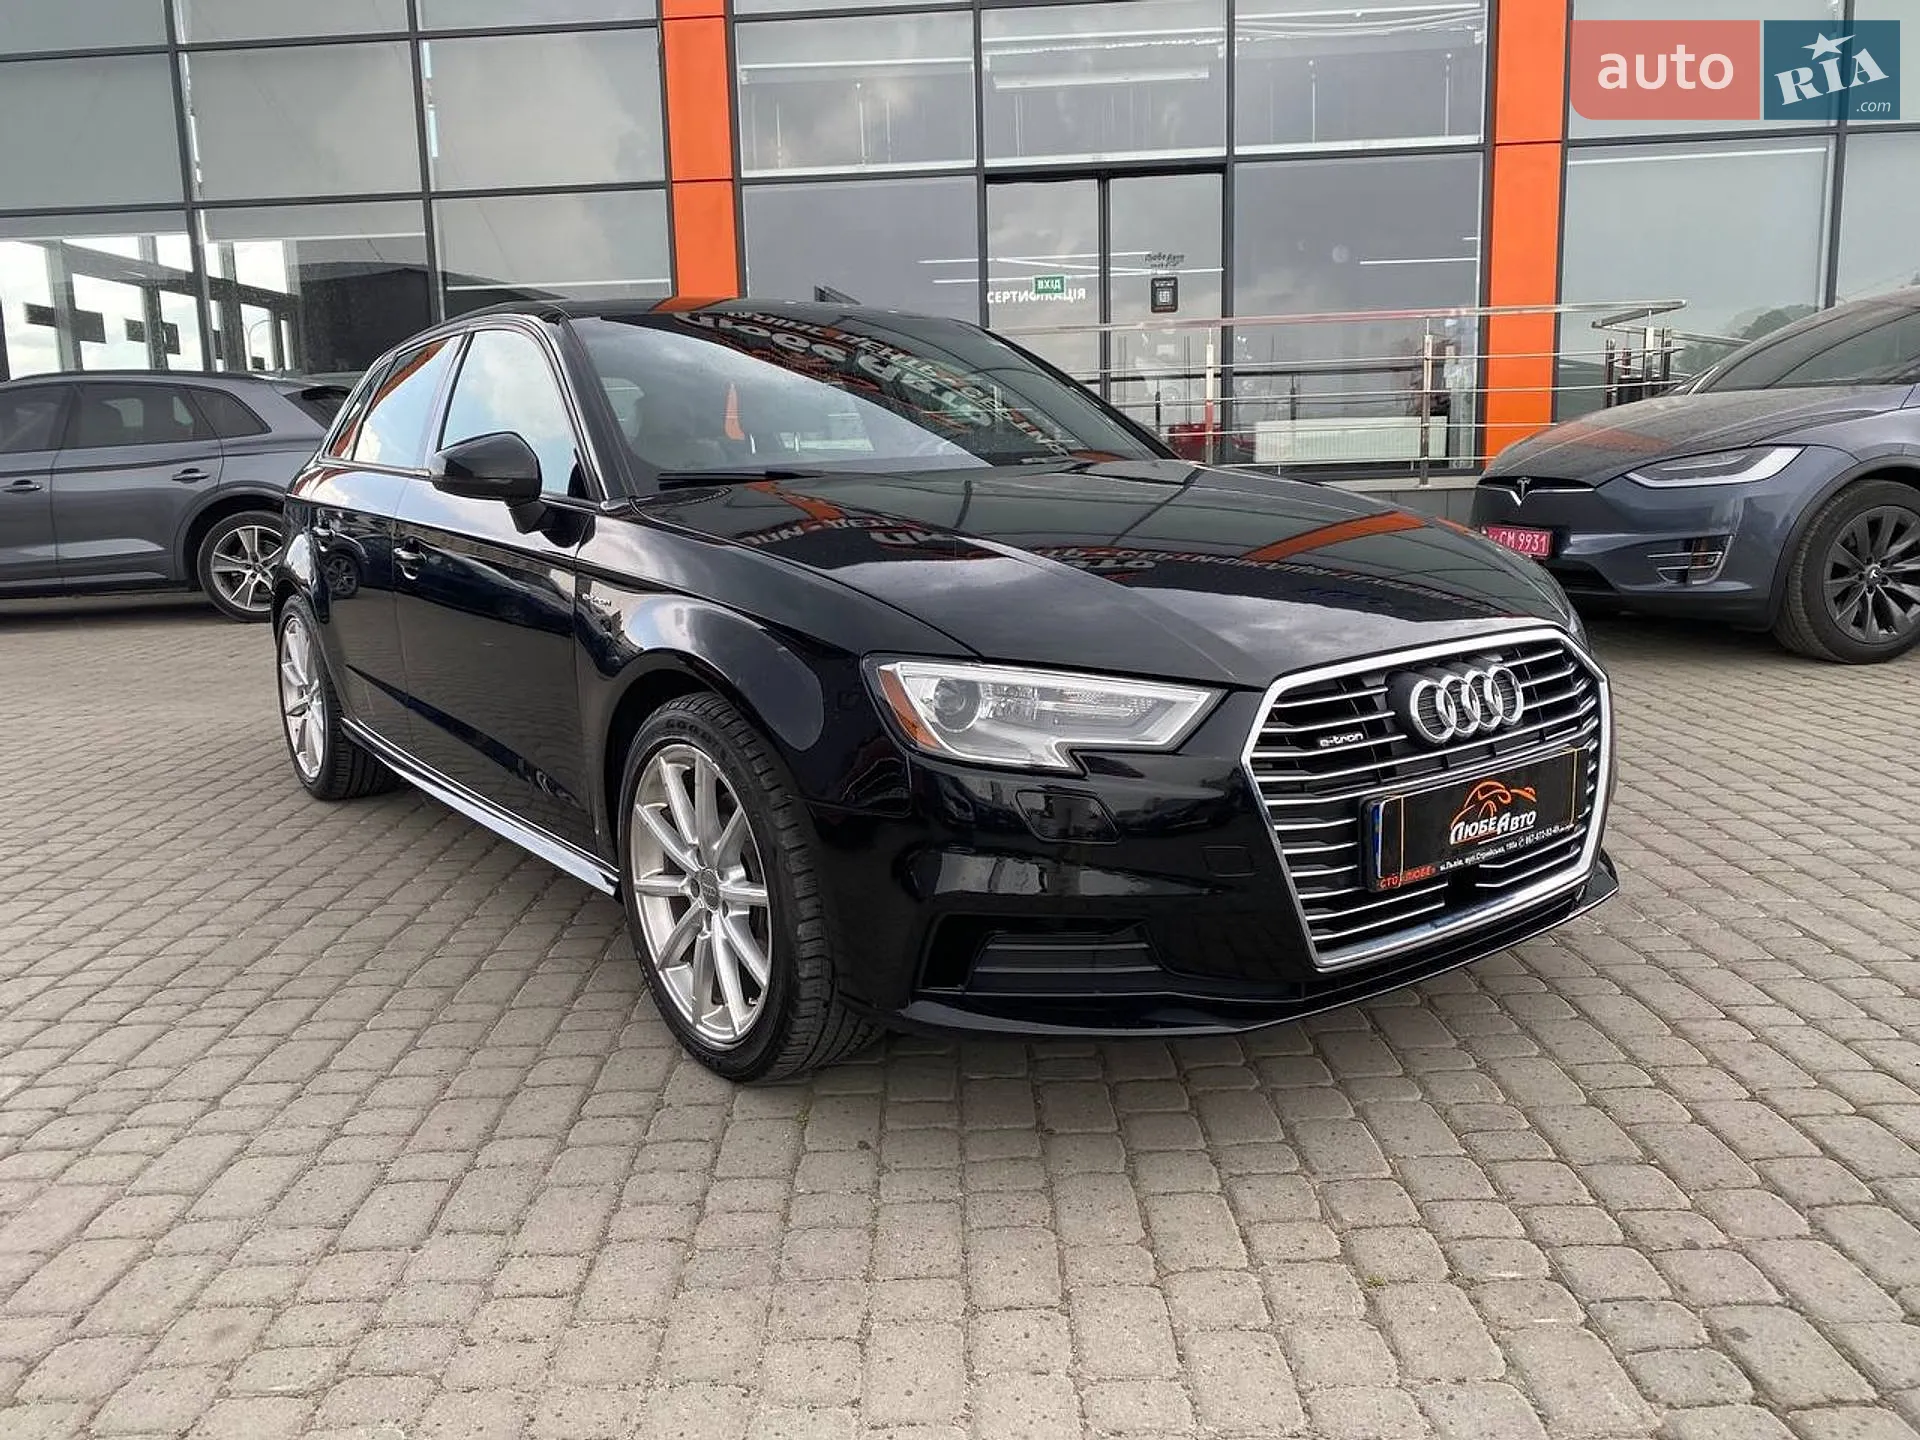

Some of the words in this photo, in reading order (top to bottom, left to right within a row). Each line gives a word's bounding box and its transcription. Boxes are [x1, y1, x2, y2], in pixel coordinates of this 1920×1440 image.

[1037, 279, 1062, 290] ВХІД
[1518, 532, 1547, 552] 9931
[1319, 732, 1364, 747] e-tron
